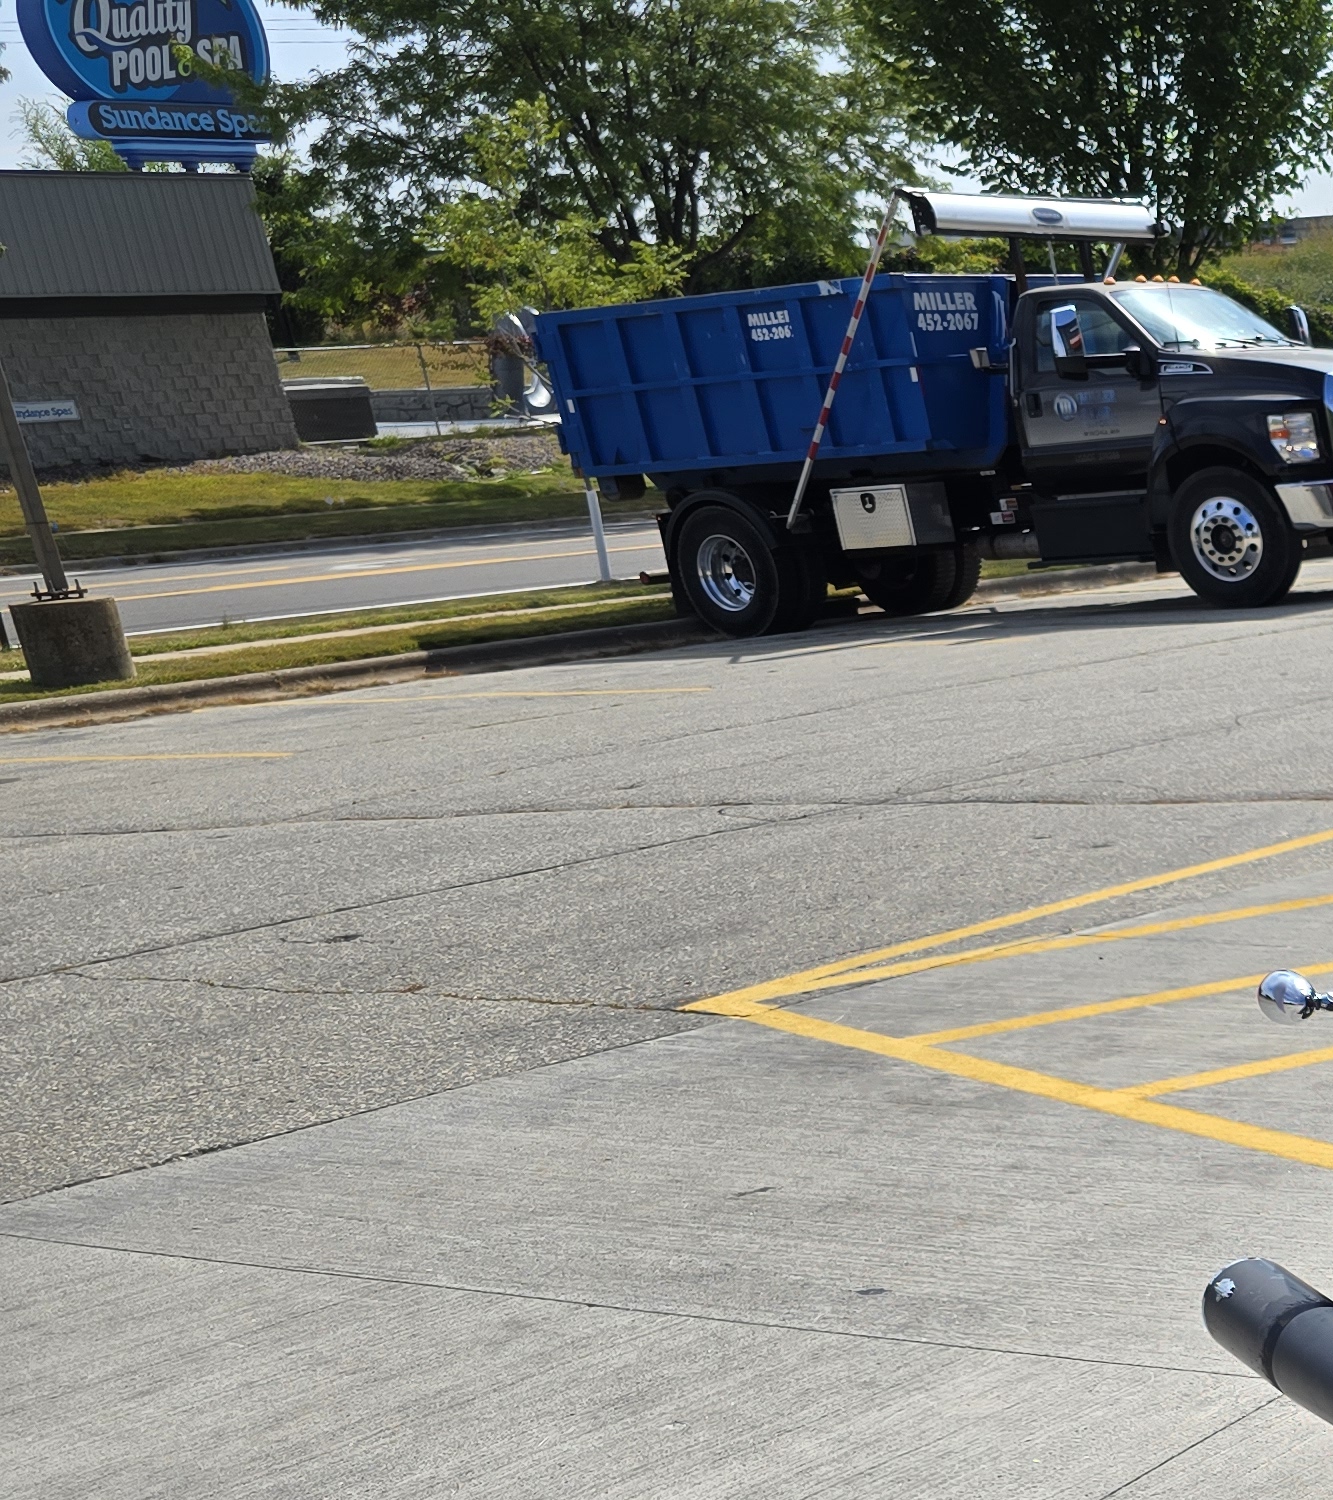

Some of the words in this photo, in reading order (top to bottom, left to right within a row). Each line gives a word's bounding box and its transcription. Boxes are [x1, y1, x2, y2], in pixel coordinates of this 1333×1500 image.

[74, 0, 192, 52] Quality
[112, 45, 176, 86] POOL
[99, 105, 216, 132] Sundance
[914, 292, 977, 311] MILLER
[917, 312, 979, 332] 452-2067
